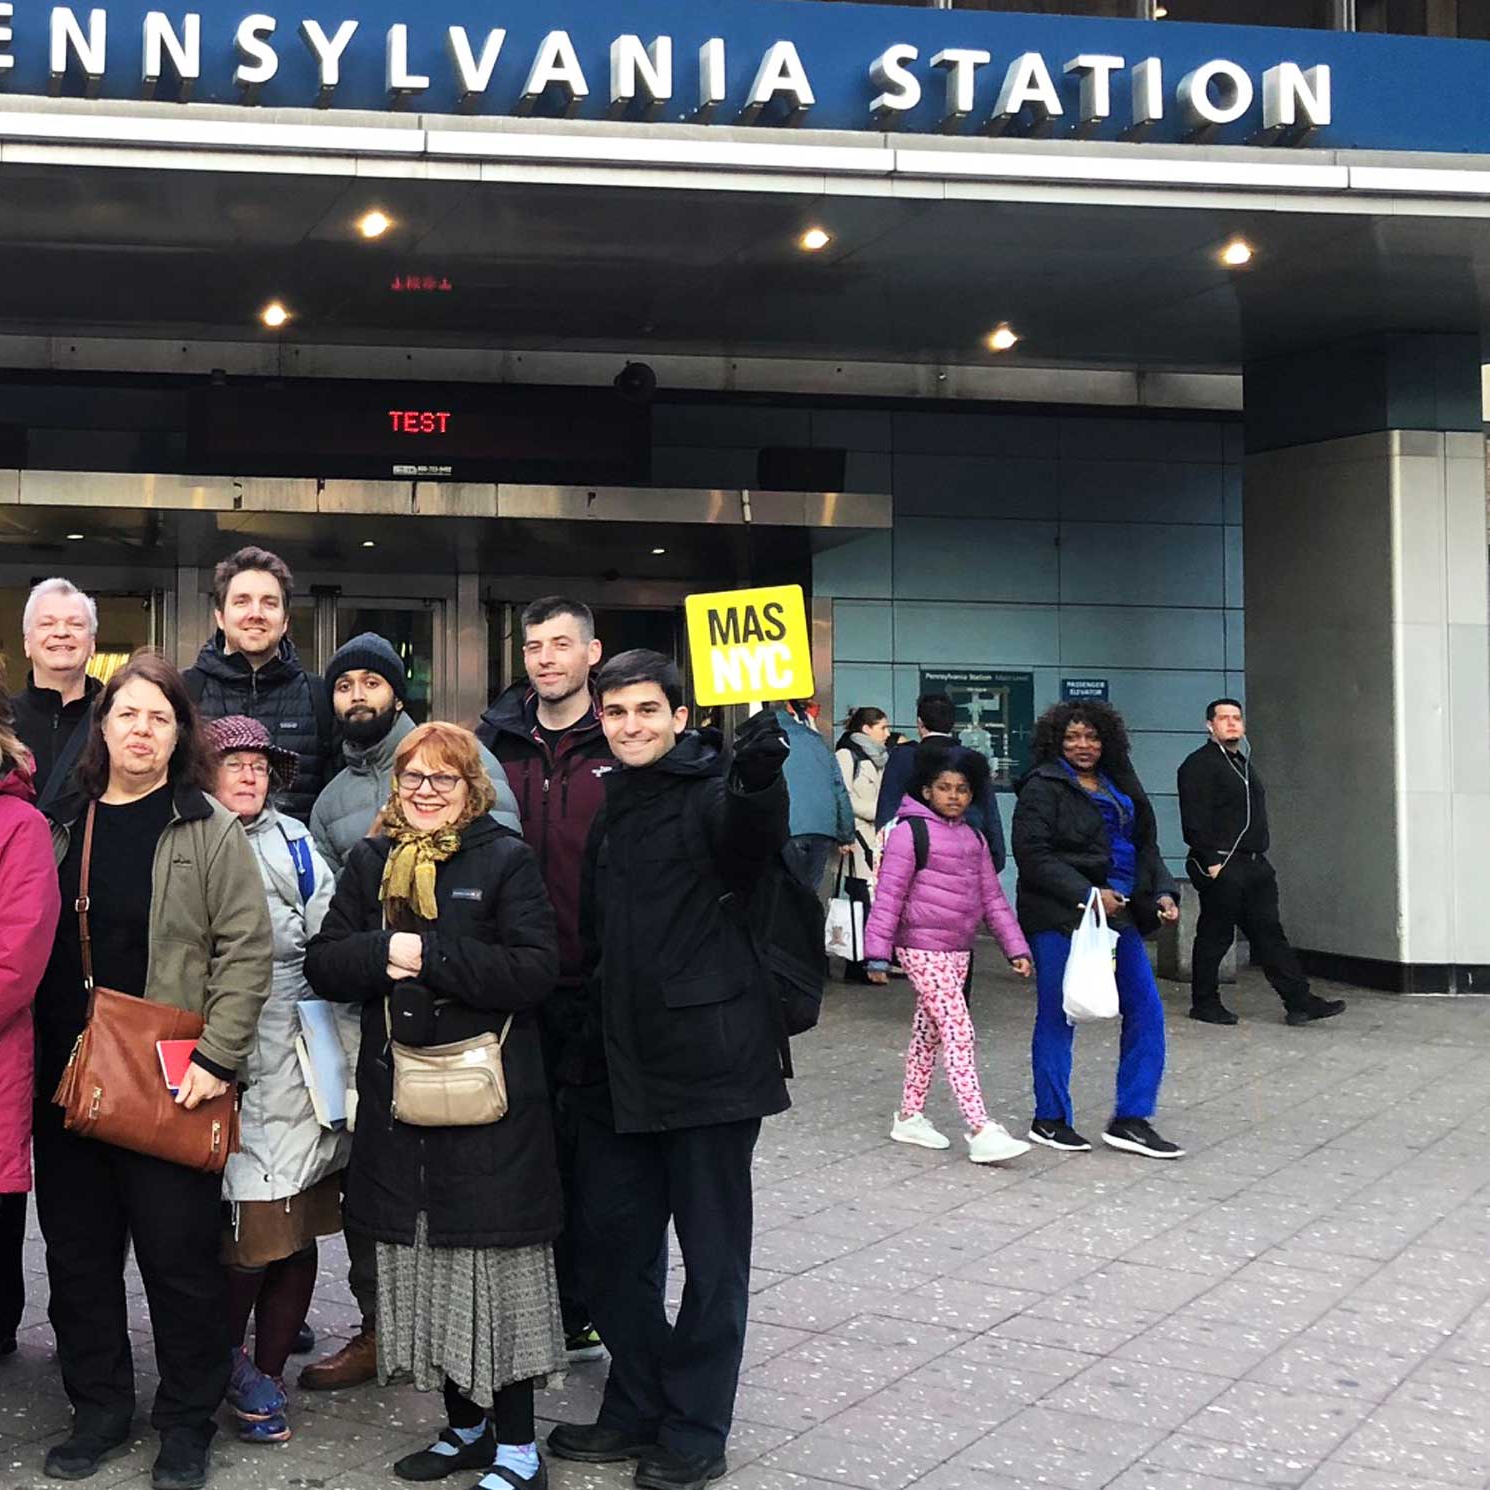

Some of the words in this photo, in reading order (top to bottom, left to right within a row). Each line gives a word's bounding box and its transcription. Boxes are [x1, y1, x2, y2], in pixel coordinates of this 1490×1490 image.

[868, 43, 1332, 128] STATION
[388, 411, 451, 433] TEST
[707, 602, 786, 646] MAS
[710, 643, 794, 694] NYC
[925, 672, 968, 681] Pennsylvania
[969, 673, 992, 681] Station
